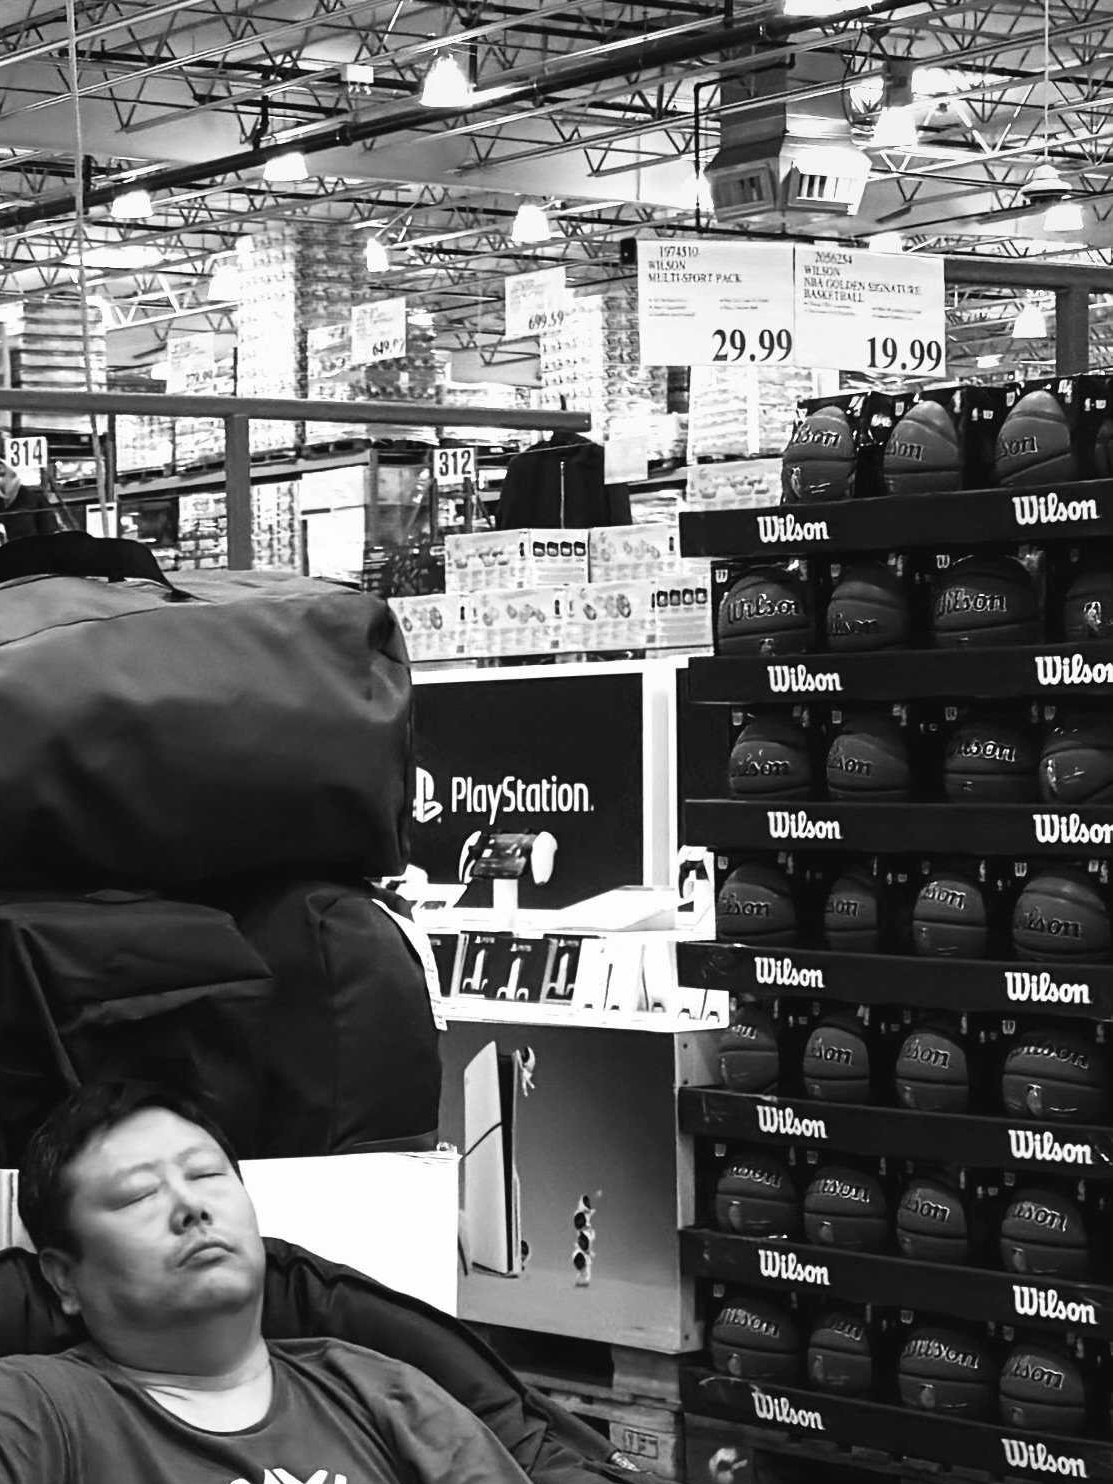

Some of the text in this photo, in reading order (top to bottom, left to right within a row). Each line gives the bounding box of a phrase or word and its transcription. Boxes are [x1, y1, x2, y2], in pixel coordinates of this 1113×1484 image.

[804, 265, 841, 276] WILSON
[712, 328, 793, 363] 29.99
[867, 337, 943, 371] 19.99
[9, 443, 44, 470] 314
[438, 451, 473, 478] 312
[1012, 494, 1101, 526] Wilson
[757, 515, 831, 543] Wilson
[767, 665, 844, 693] Wilson
[451, 775, 589, 825] PlayStation
[767, 811, 844, 840] Wilson
[754, 957, 825, 988] Wilson
[1005, 971, 1093, 1004] Wilson
[756, 1105, 829, 1139] Wilson
[1008, 1129, 1095, 1165] Wilson
[758, 1249, 831, 1286] Wilson
[1012, 1285, 1100, 1325] Wilson
[752, 1391, 826, 1430] Wilson
[1001, 1438, 1090, 1479] Wilson
